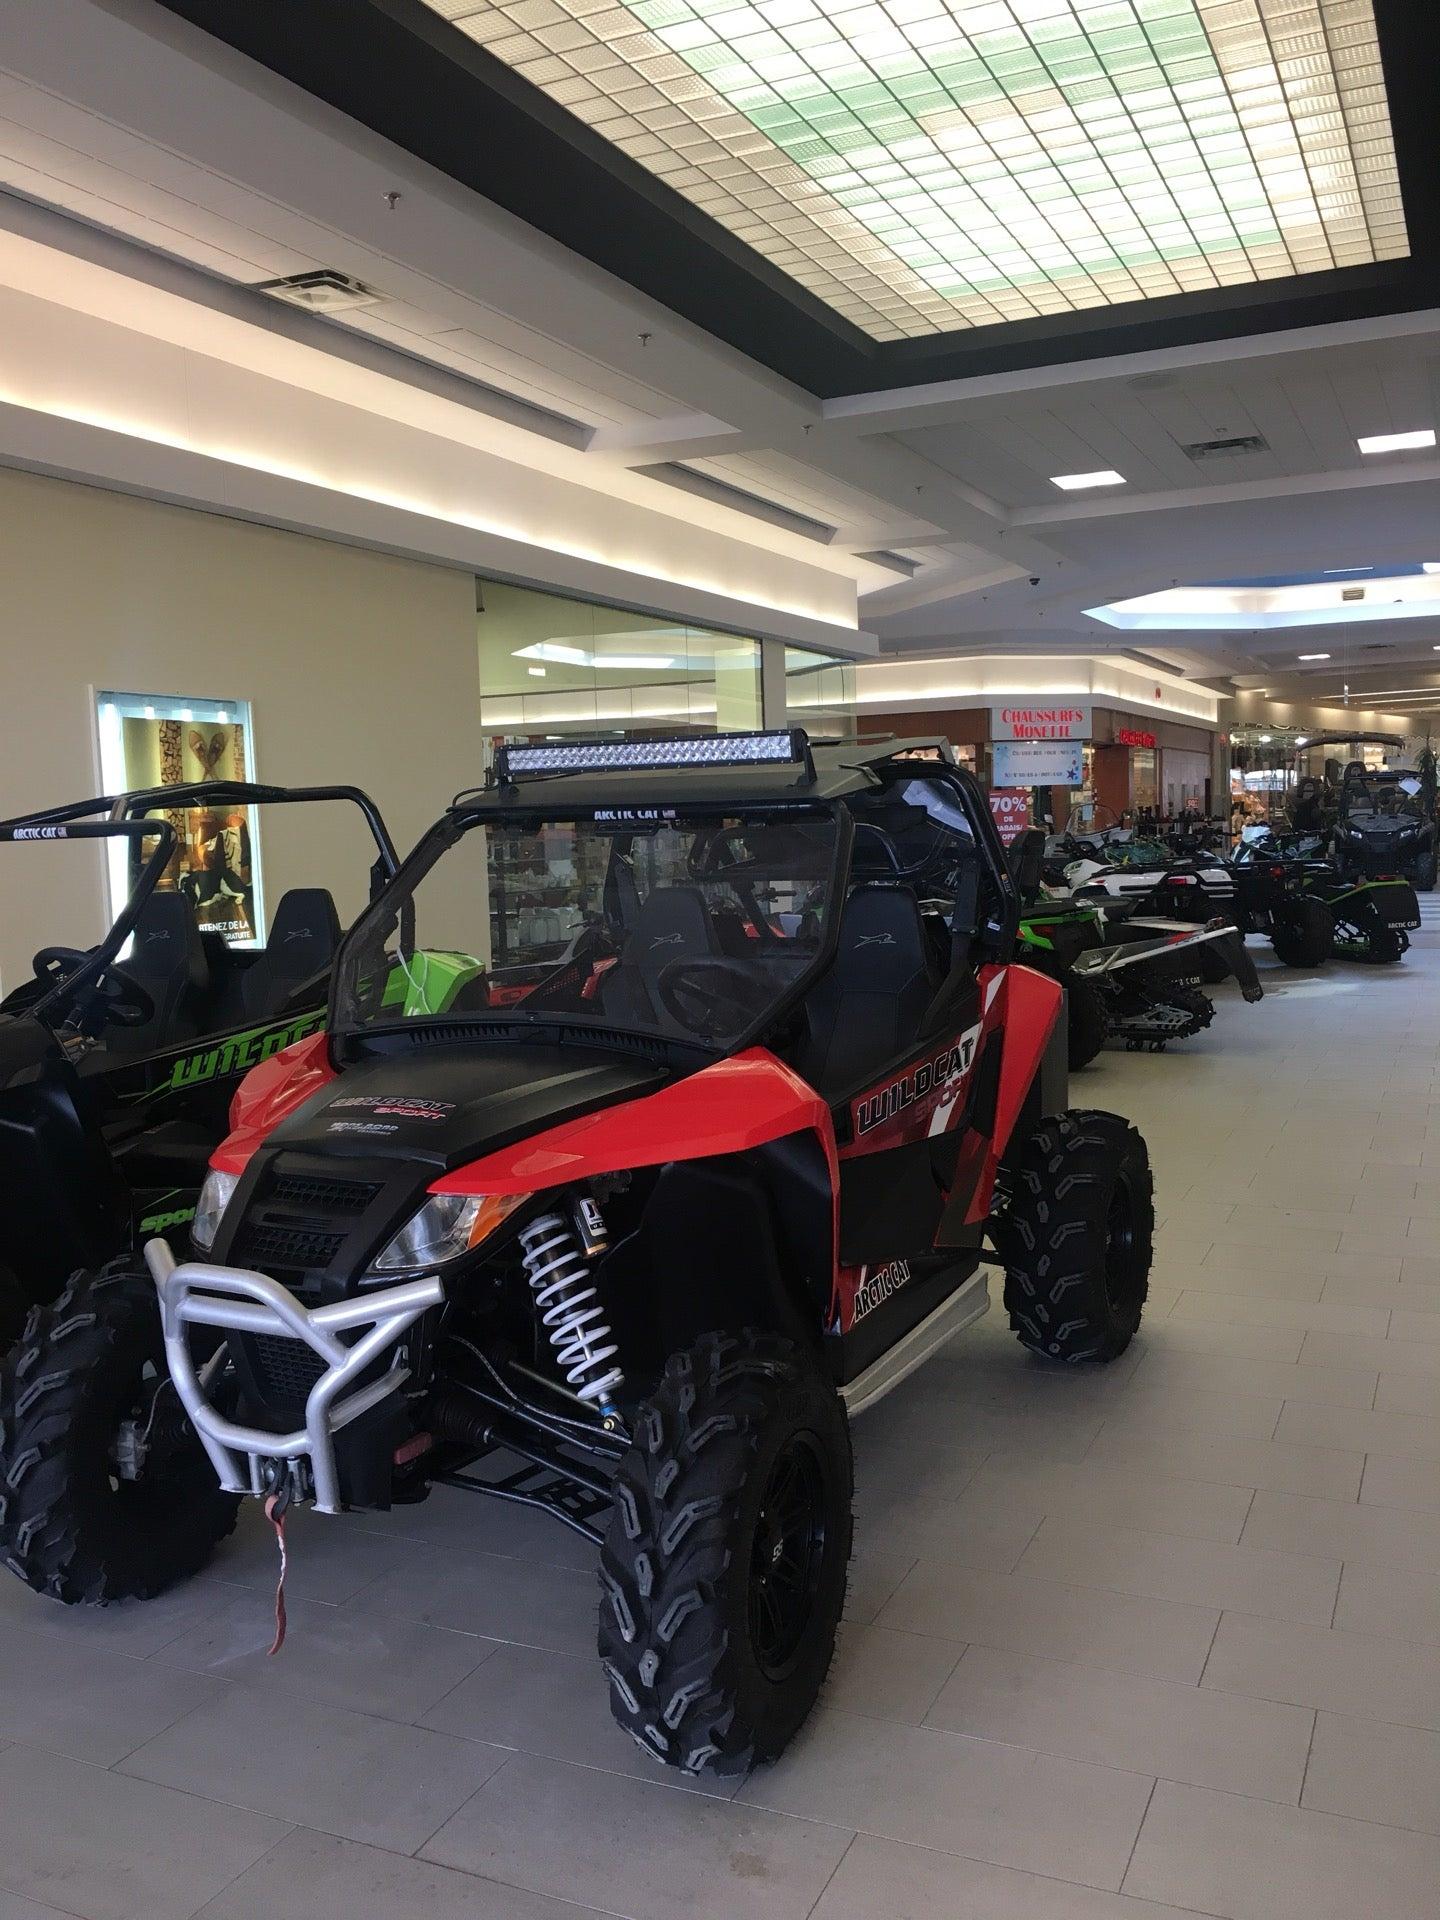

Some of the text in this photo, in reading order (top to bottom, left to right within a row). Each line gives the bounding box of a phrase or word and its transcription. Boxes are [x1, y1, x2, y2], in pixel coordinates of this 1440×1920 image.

[990, 796, 1027, 813] 70%
[13, 826, 57, 839] ARCTIC CAT
[228, 920, 239, 930] DE
[239, 920, 249, 929] LA
[857, 1036, 974, 1136] WILDCAT
[329, 1096, 457, 1111] WILDCAT
[854, 1259, 911, 1324] ARCTIC CAT
